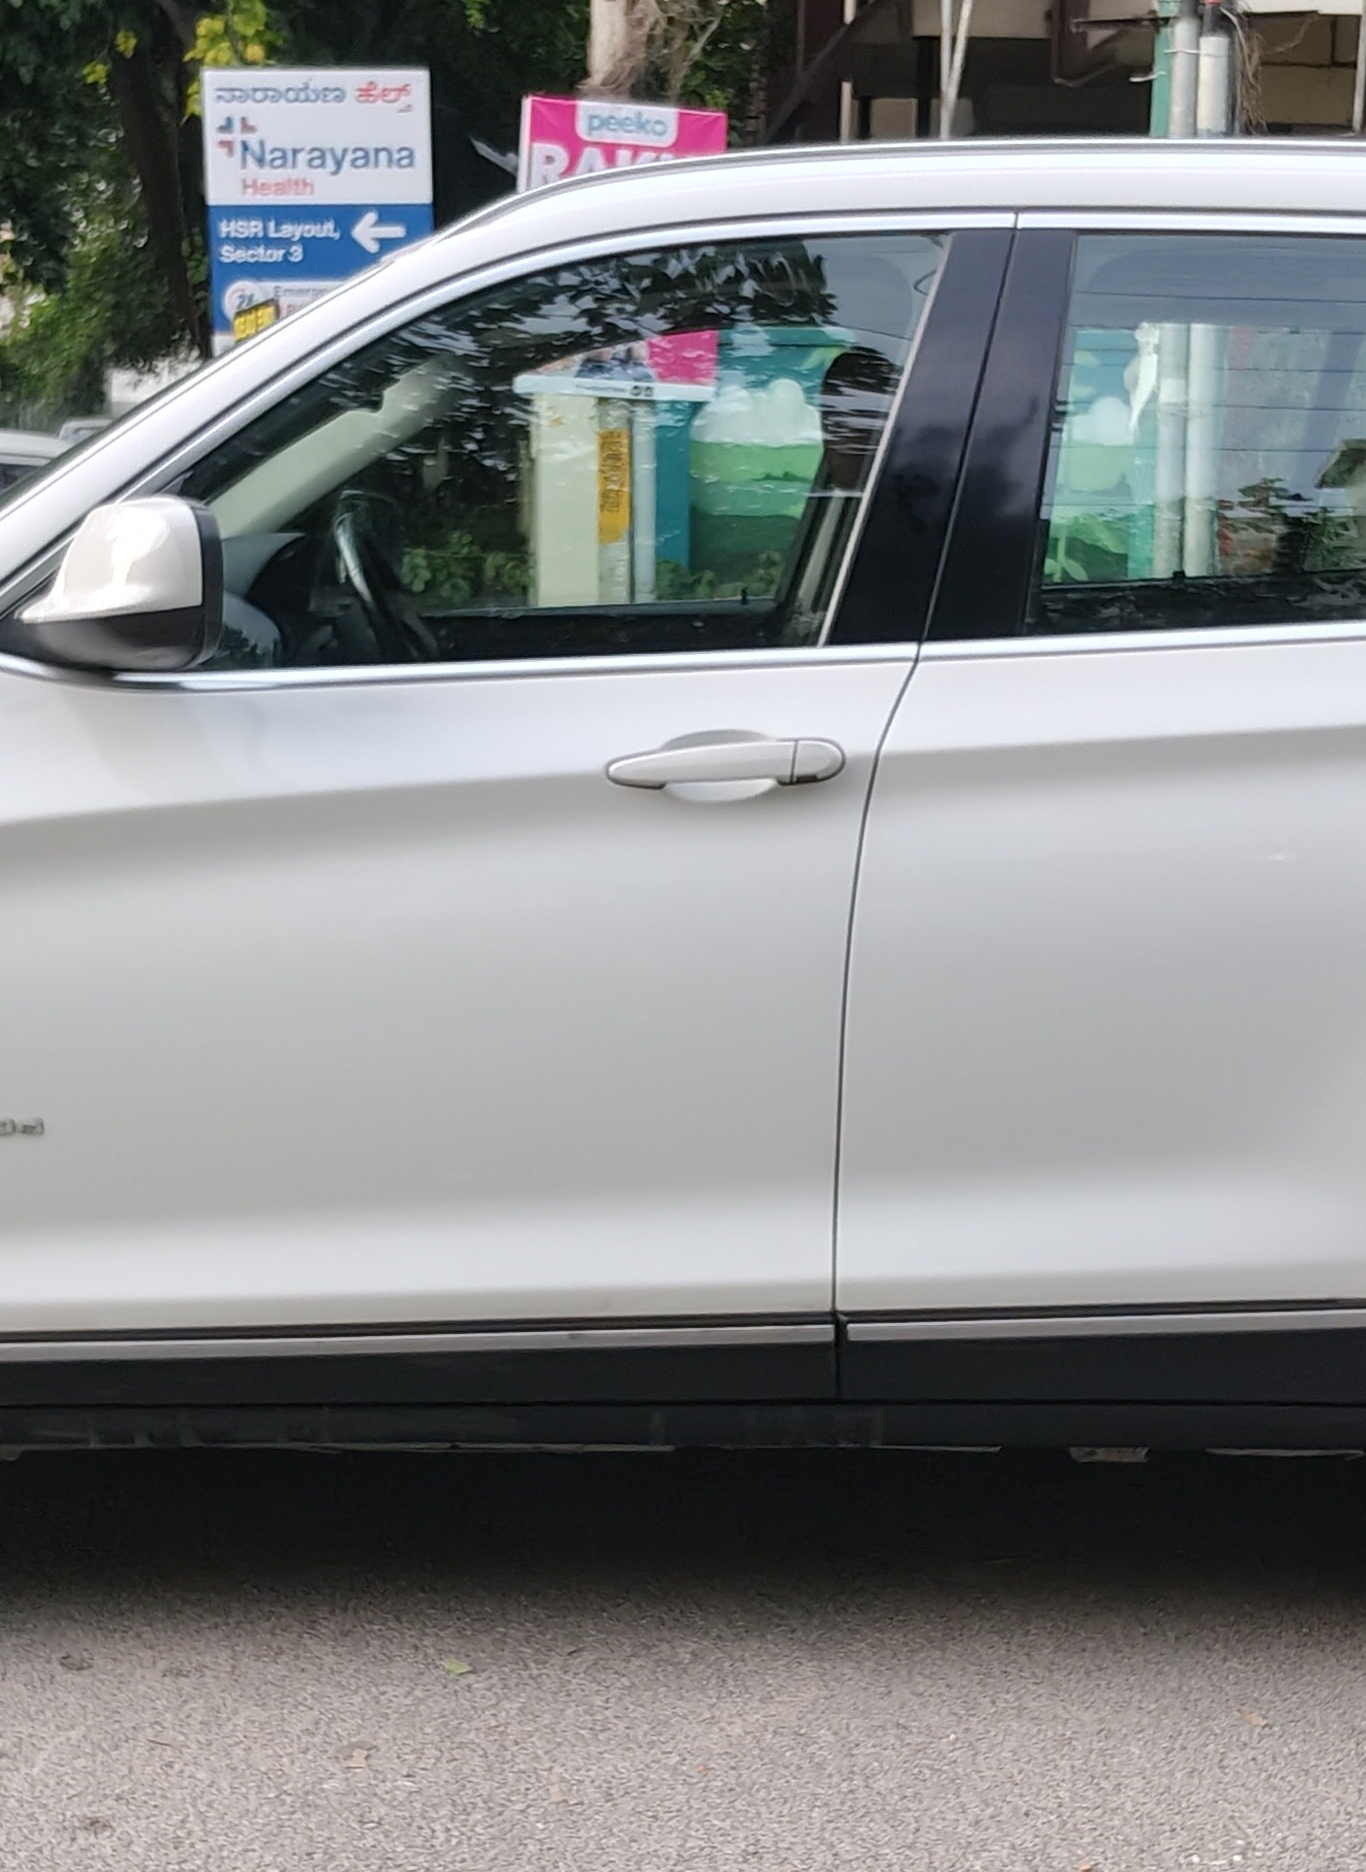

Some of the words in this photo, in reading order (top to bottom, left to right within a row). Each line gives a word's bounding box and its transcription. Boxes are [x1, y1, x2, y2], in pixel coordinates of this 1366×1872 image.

[587, 112, 668, 137] peeko
[239, 139, 416, 176] Narayana
[242, 178, 315, 197] Health
[219, 218, 264, 239] HSR
[268, 218, 341, 242] Layout,
[219, 244, 286, 264] Sector
[287, 244, 304, 263] 3
